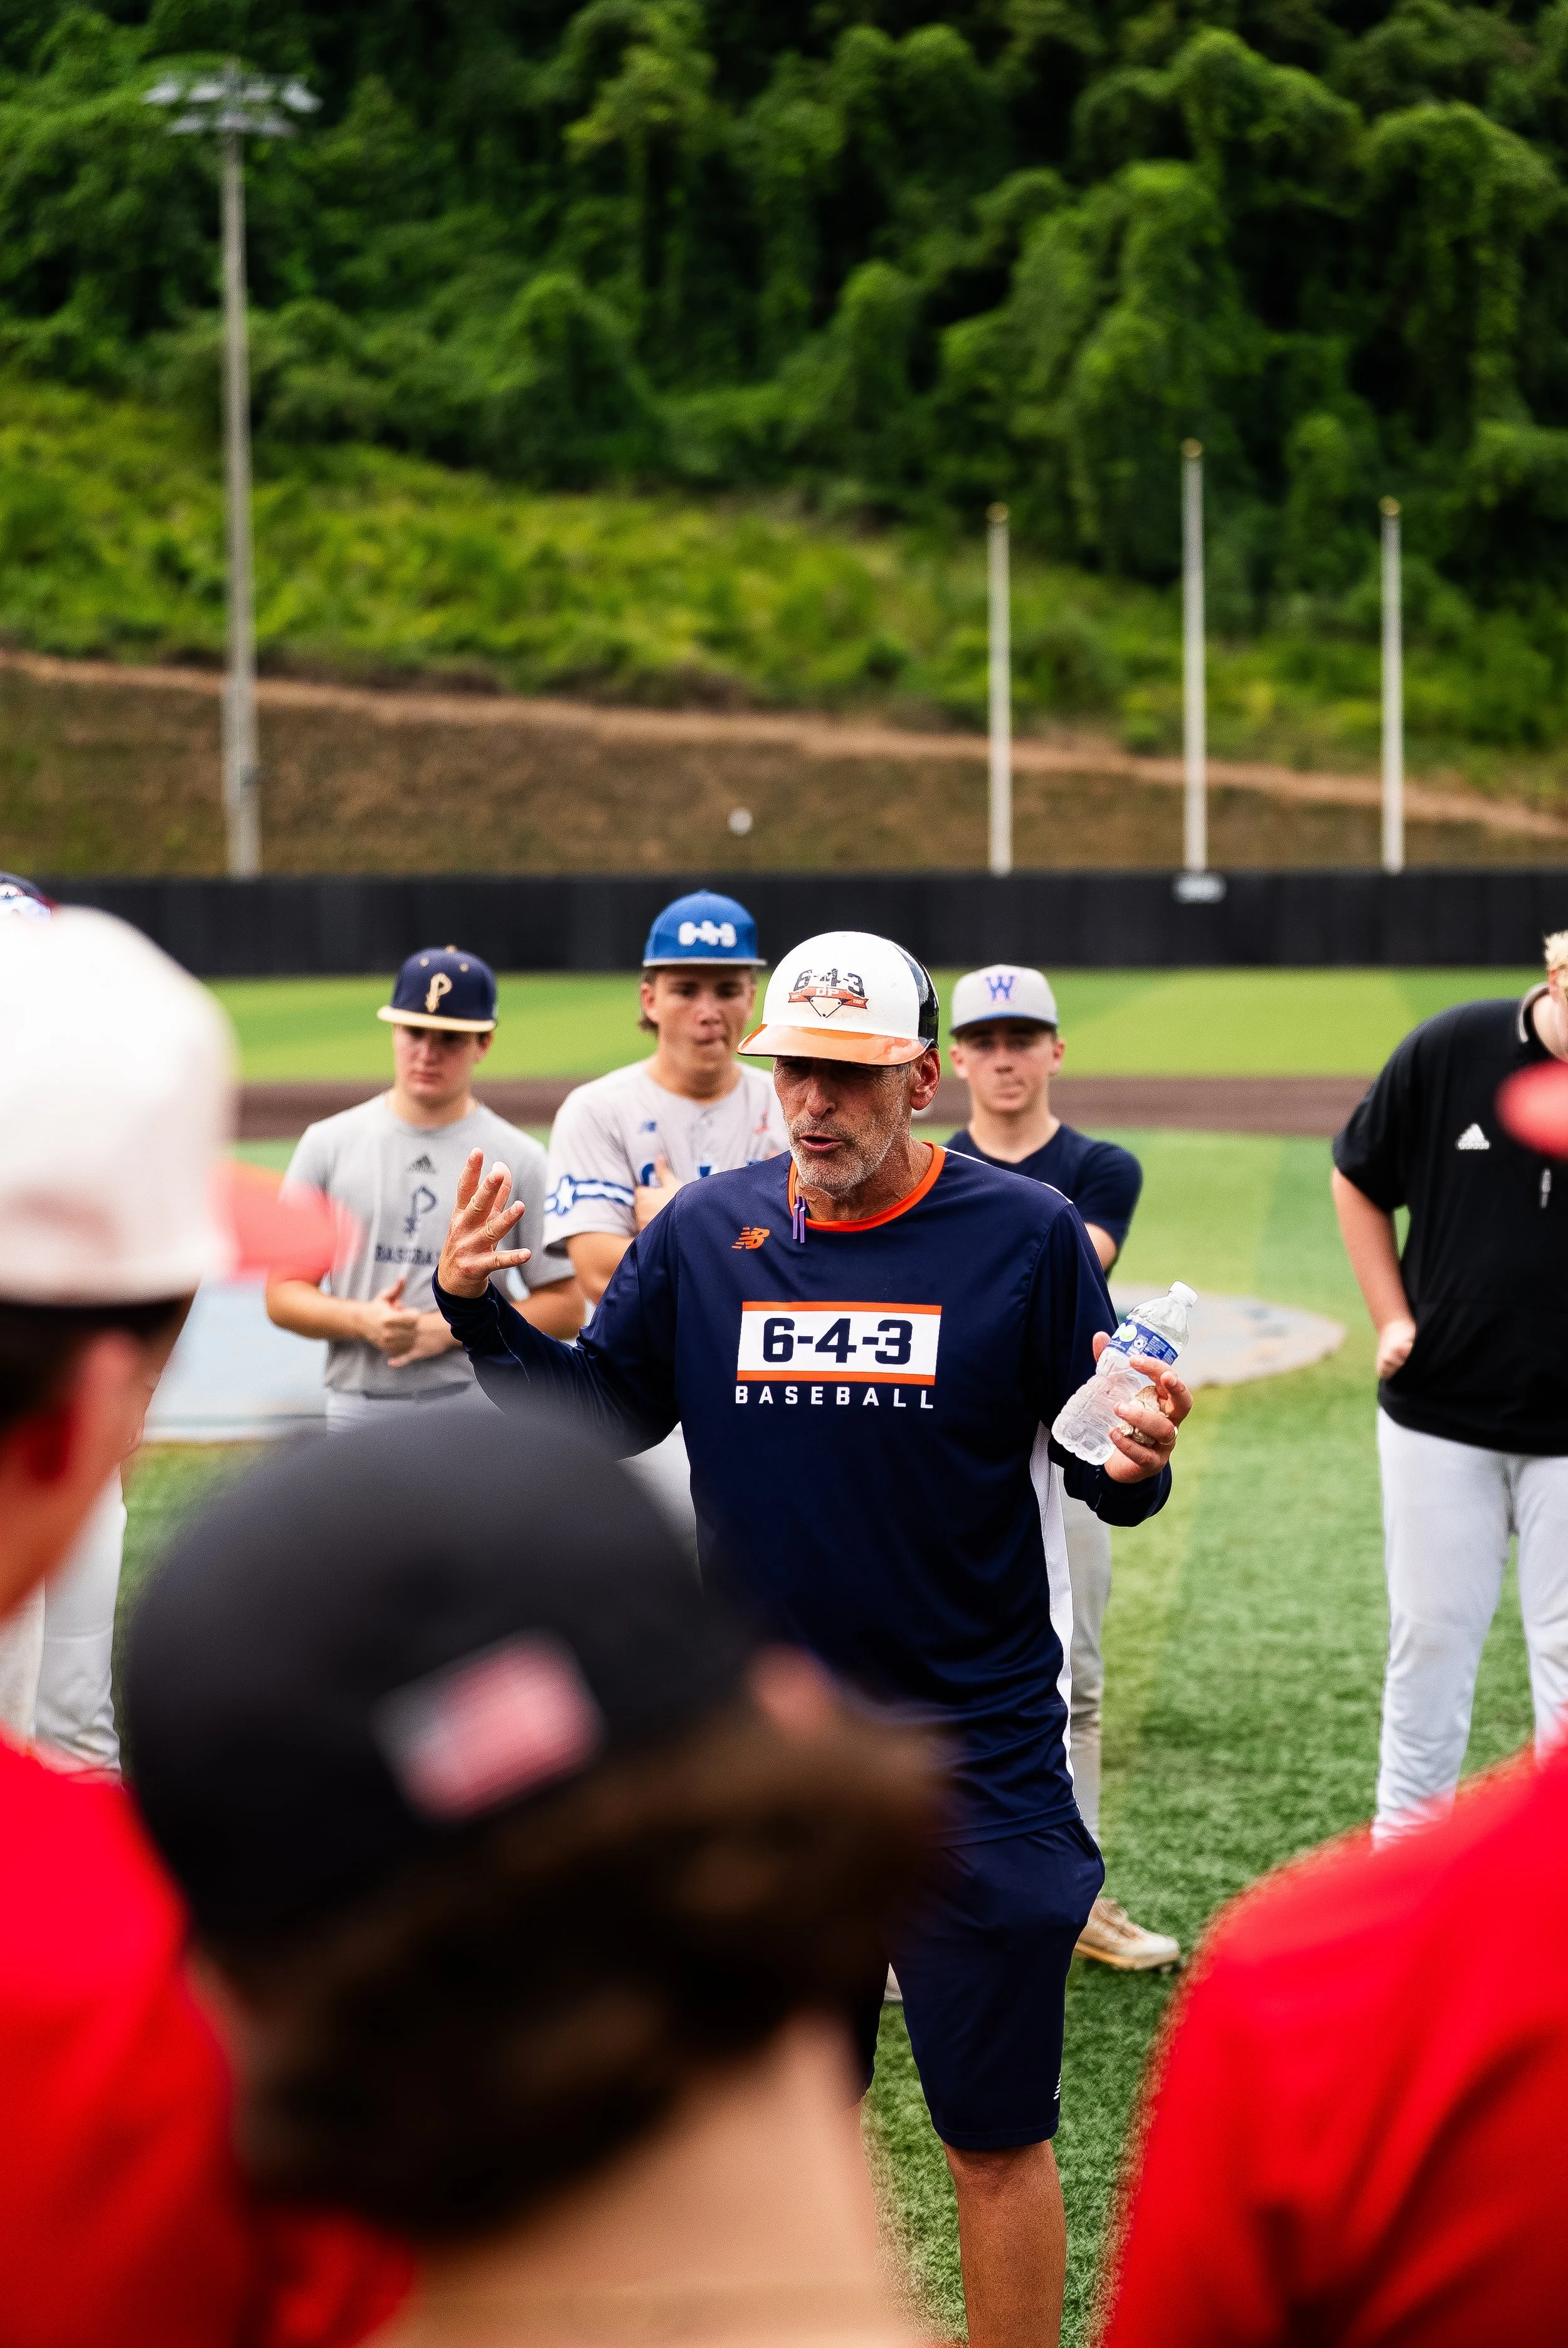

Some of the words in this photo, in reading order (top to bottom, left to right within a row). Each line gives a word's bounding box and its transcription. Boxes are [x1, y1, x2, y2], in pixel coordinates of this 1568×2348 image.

[425, 972, 452, 1013] P
[793, 969, 866, 997] 6-4-3
[815, 988, 841, 996] DP
[985, 975, 1015, 1002] W
[763, 1317, 913, 1365] 6-4-3
[735, 1385, 934, 1409] BASEBALL
